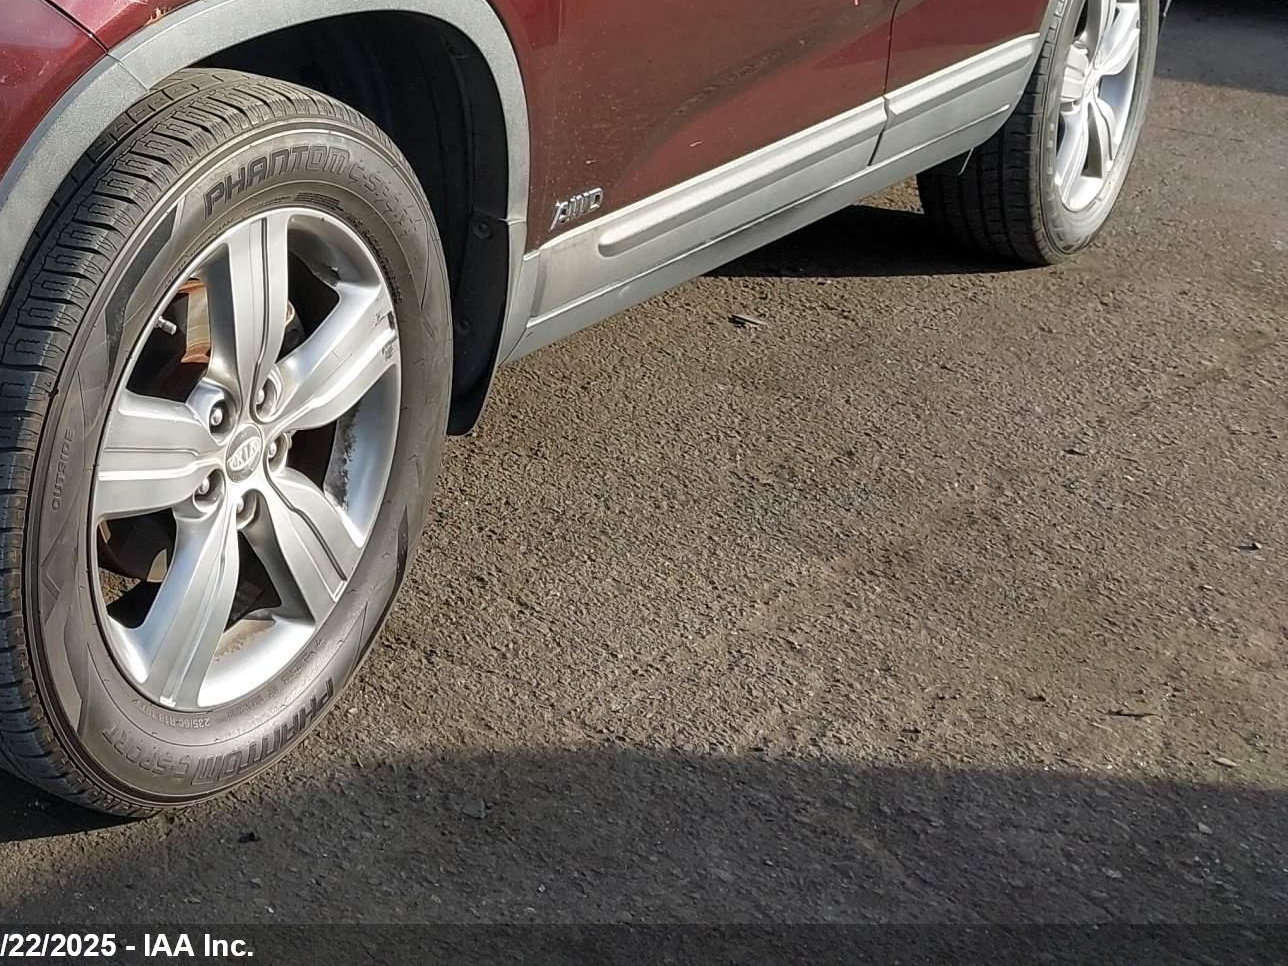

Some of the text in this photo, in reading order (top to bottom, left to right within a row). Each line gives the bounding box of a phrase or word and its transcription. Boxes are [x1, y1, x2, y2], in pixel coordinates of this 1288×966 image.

[203, 145, 351, 220] PHANTOM
[229, 438, 261, 470] KIA
[190, 676, 334, 786] PHANTOM
